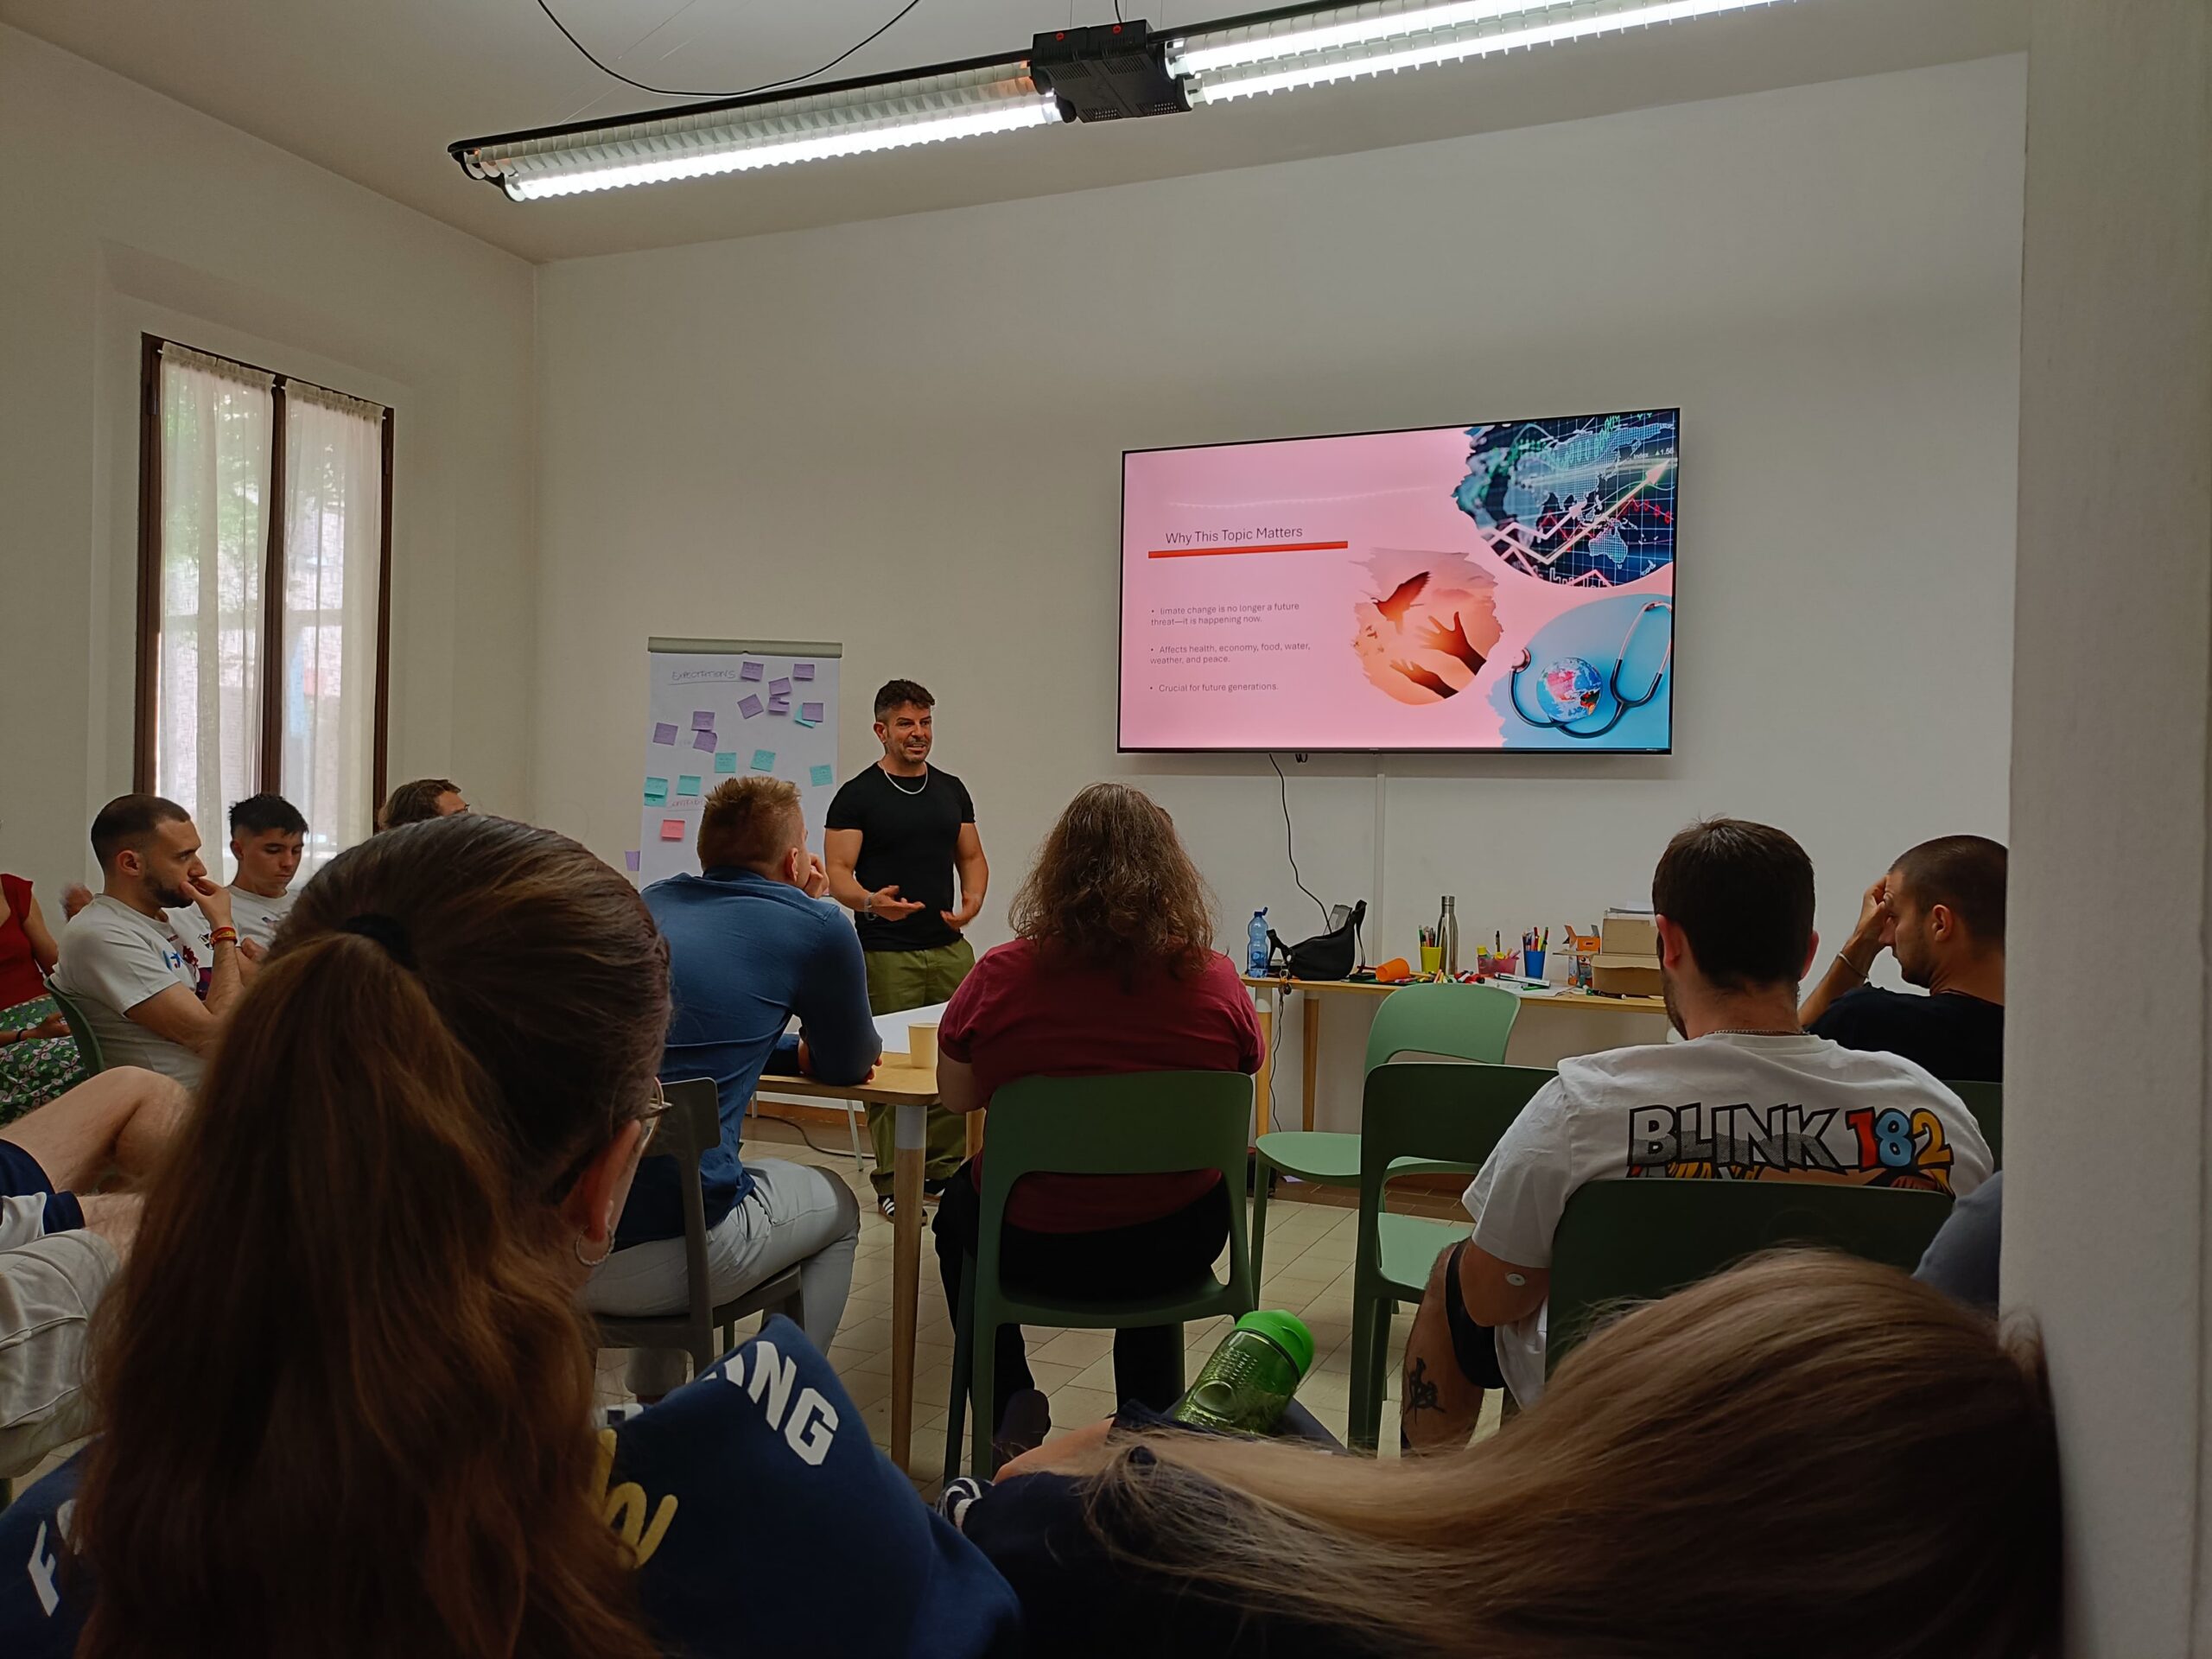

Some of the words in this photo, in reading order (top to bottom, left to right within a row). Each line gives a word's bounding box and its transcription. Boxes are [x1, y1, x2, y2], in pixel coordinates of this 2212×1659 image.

[1166, 532, 1192, 546] Why
[1195, 531, 1218, 542] This
[1222, 529, 1253, 543] Topic
[1256, 527, 1303, 538] Matters
[1187, 606, 1217, 615] change
[1239, 604, 1265, 613] longer
[1274, 602, 1300, 611] future
[1198, 616, 1242, 626] happening
[1159, 645, 1187, 654] Affects
[1189, 645, 1217, 654] health,
[1218, 645, 1259, 653] economy,
[1261, 643, 1282, 652] food,
[1203, 656, 1230, 664] peace.
[1159, 683, 1187, 692] Crucial
[1228, 683, 1279, 693] generations.
[1628, 1103, 1840, 1175] BLINK
[1846, 1106, 1955, 1171] 182
